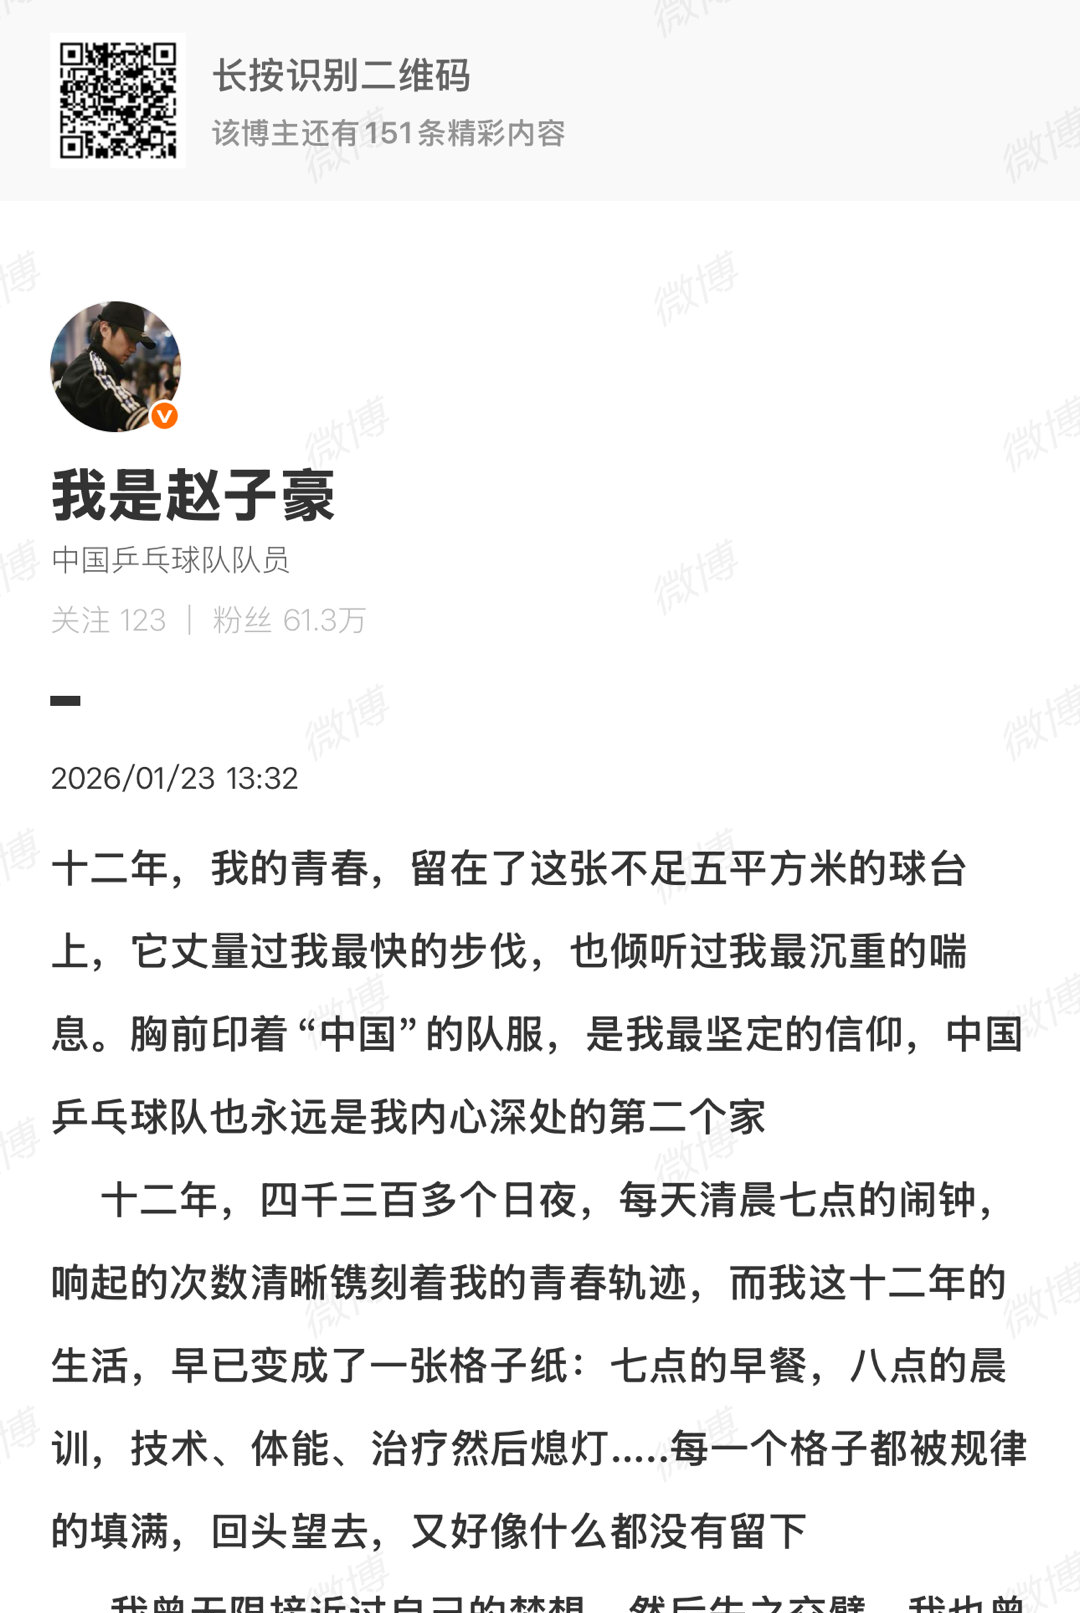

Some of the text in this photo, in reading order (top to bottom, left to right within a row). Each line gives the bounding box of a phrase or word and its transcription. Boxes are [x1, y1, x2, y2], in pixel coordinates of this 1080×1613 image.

[213, 58, 469, 92] 长按识别二维码
[212, 119, 564, 147] 该博主还有151条精彩内容
[52, 467, 334, 522] 我是赵子豪
[53, 545, 289, 574] 中国乒乓球队队员
[52, 606, 365, 633] 关注 123 粉丝 61.3万
[52, 764, 298, 792] 2026/01/23 13:32
[52, 849, 966, 889] 十二年，我的青春，留在了这张不足五平方米的球台
[52, 932, 966, 972] 上，它丈量过我最快的步伐，也倾听过我最沉重的喘
[52, 1015, 1021, 1055] 息。胸前印着“中国”的队服，是我最坚定的信仰，中国
[52, 1098, 765, 1135] 乒乓球队也永远是我内心深处的第二个家
[101, 1181, 989, 1220] 十二年，四千三百多个日夜，每天清晨七点的闹钟，
[53, 1263, 1004, 1303] 响起的次数清晰镌刻着我的青春轨迹，而我这十二年的
[52, 1346, 1005, 1386] 生活，早已变成了一张格子纸：七点的早餐，八点的晨
[52, 1429, 1026, 1469] 训，技术、体能、治疗然后熄灯.....每一个格子都被规律
[53, 1512, 806, 1552] 的填满，回头望去，又好像什么都没有留下
